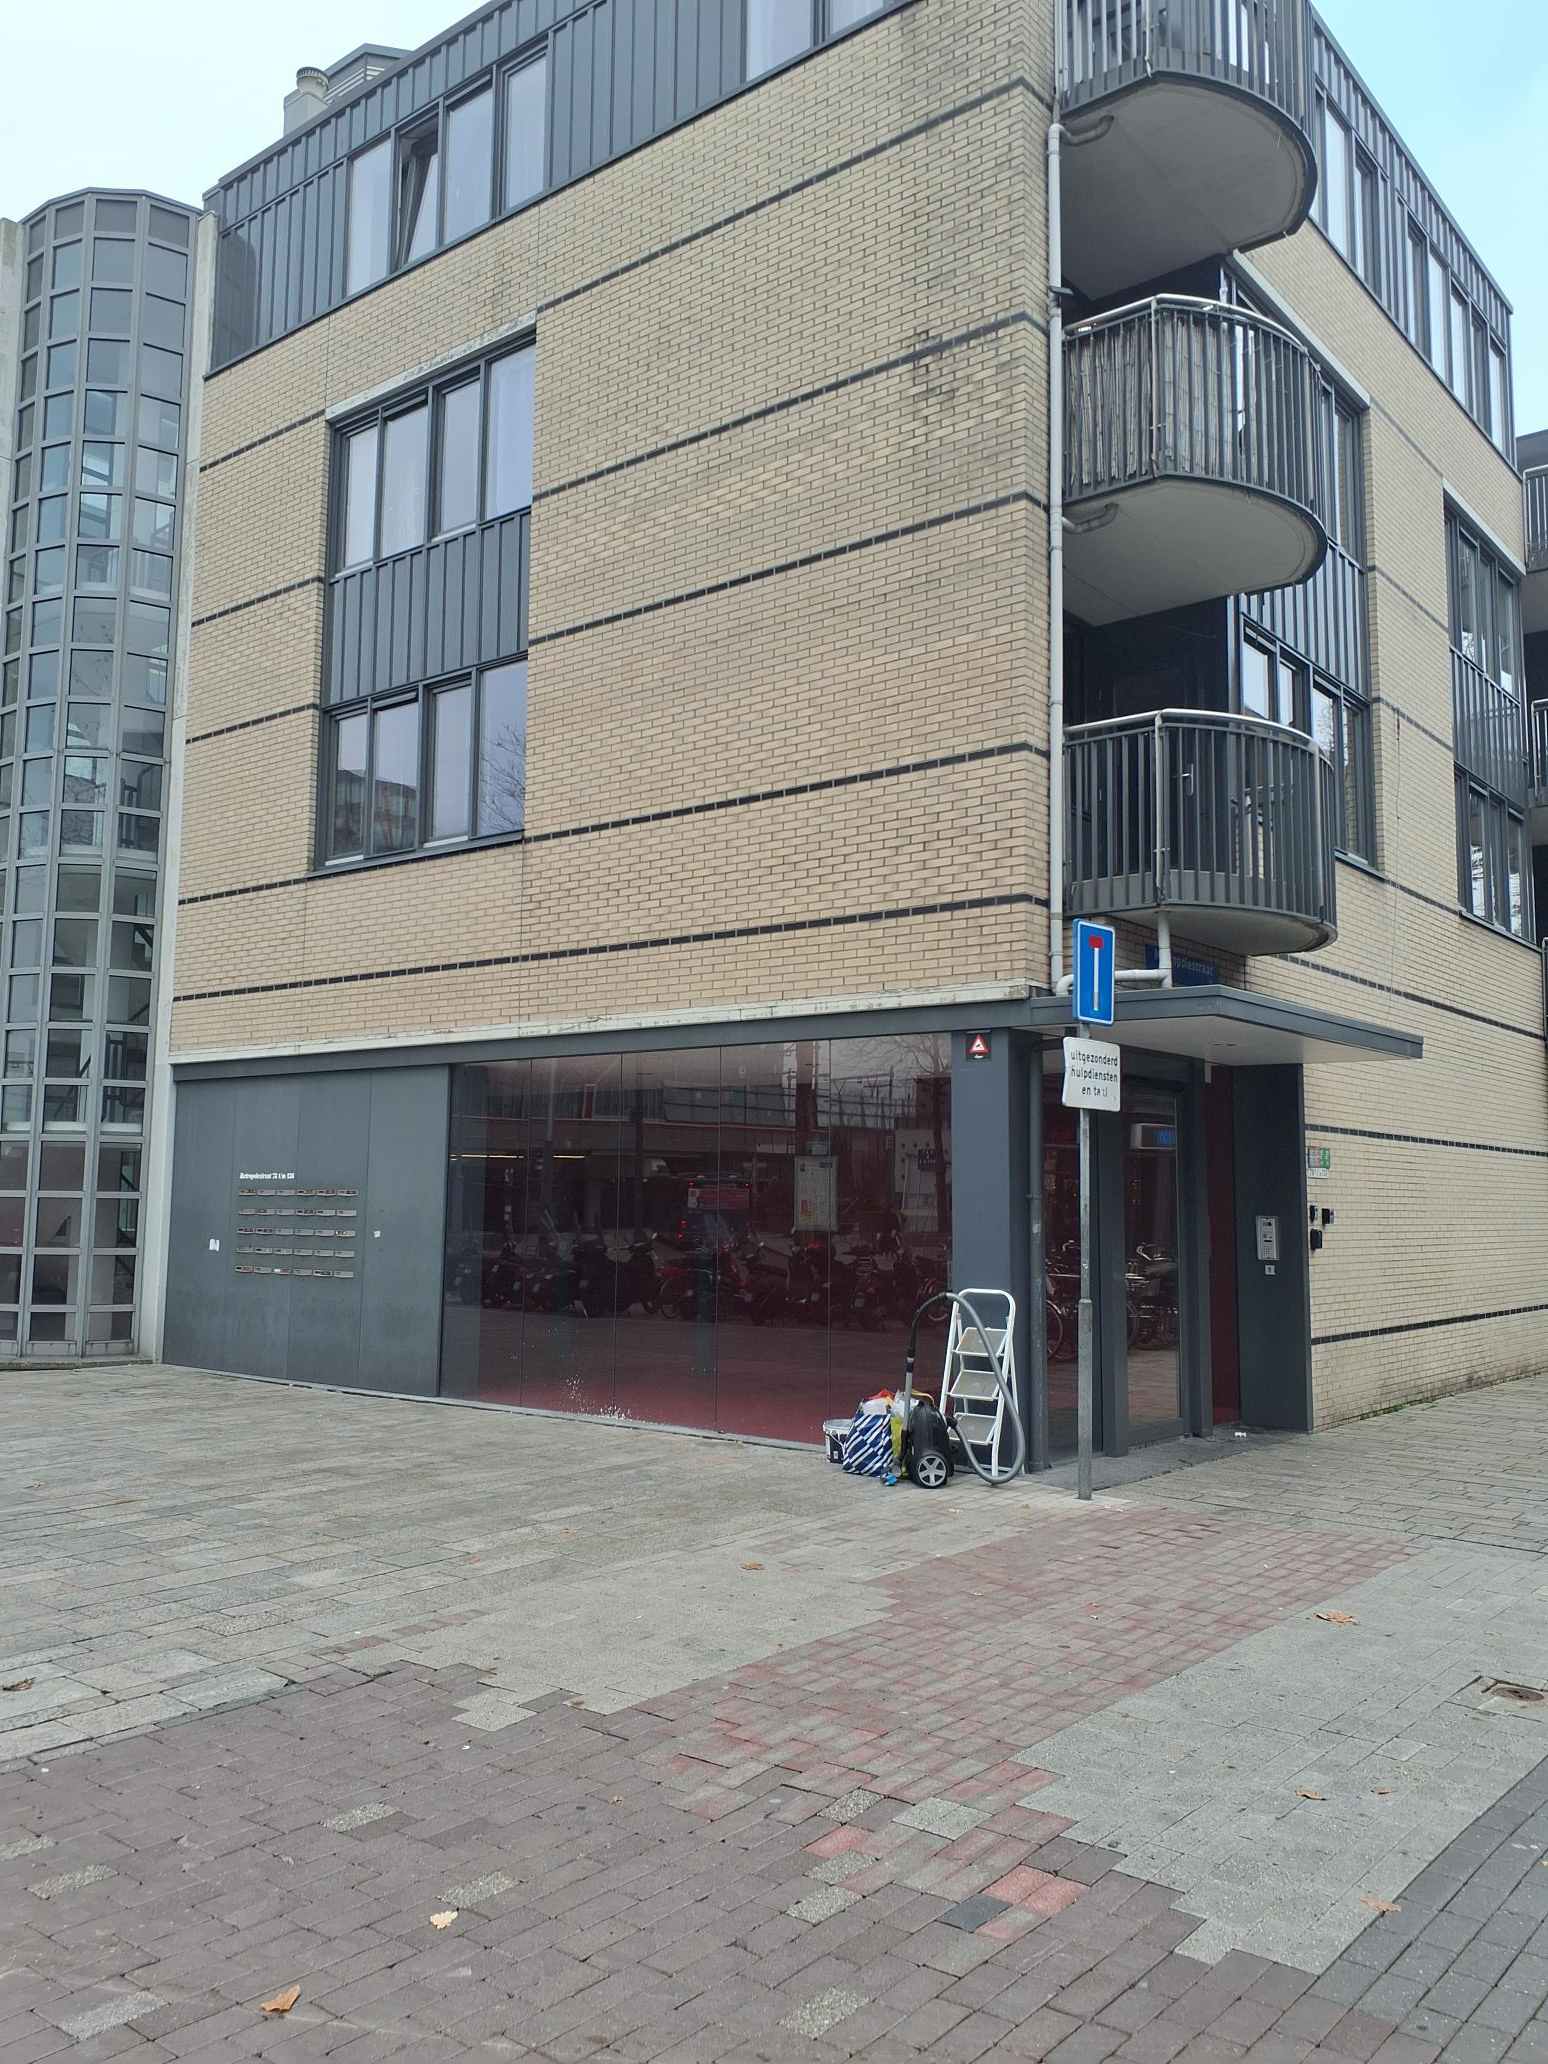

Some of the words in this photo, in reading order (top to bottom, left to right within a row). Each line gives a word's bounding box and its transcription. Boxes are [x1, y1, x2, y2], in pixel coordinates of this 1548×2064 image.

[1070, 1050, 1118, 1066] uitgezonderd
[1071, 1066, 1118, 1083] hulpdiensten
[1082, 1086, 1091, 1096] en
